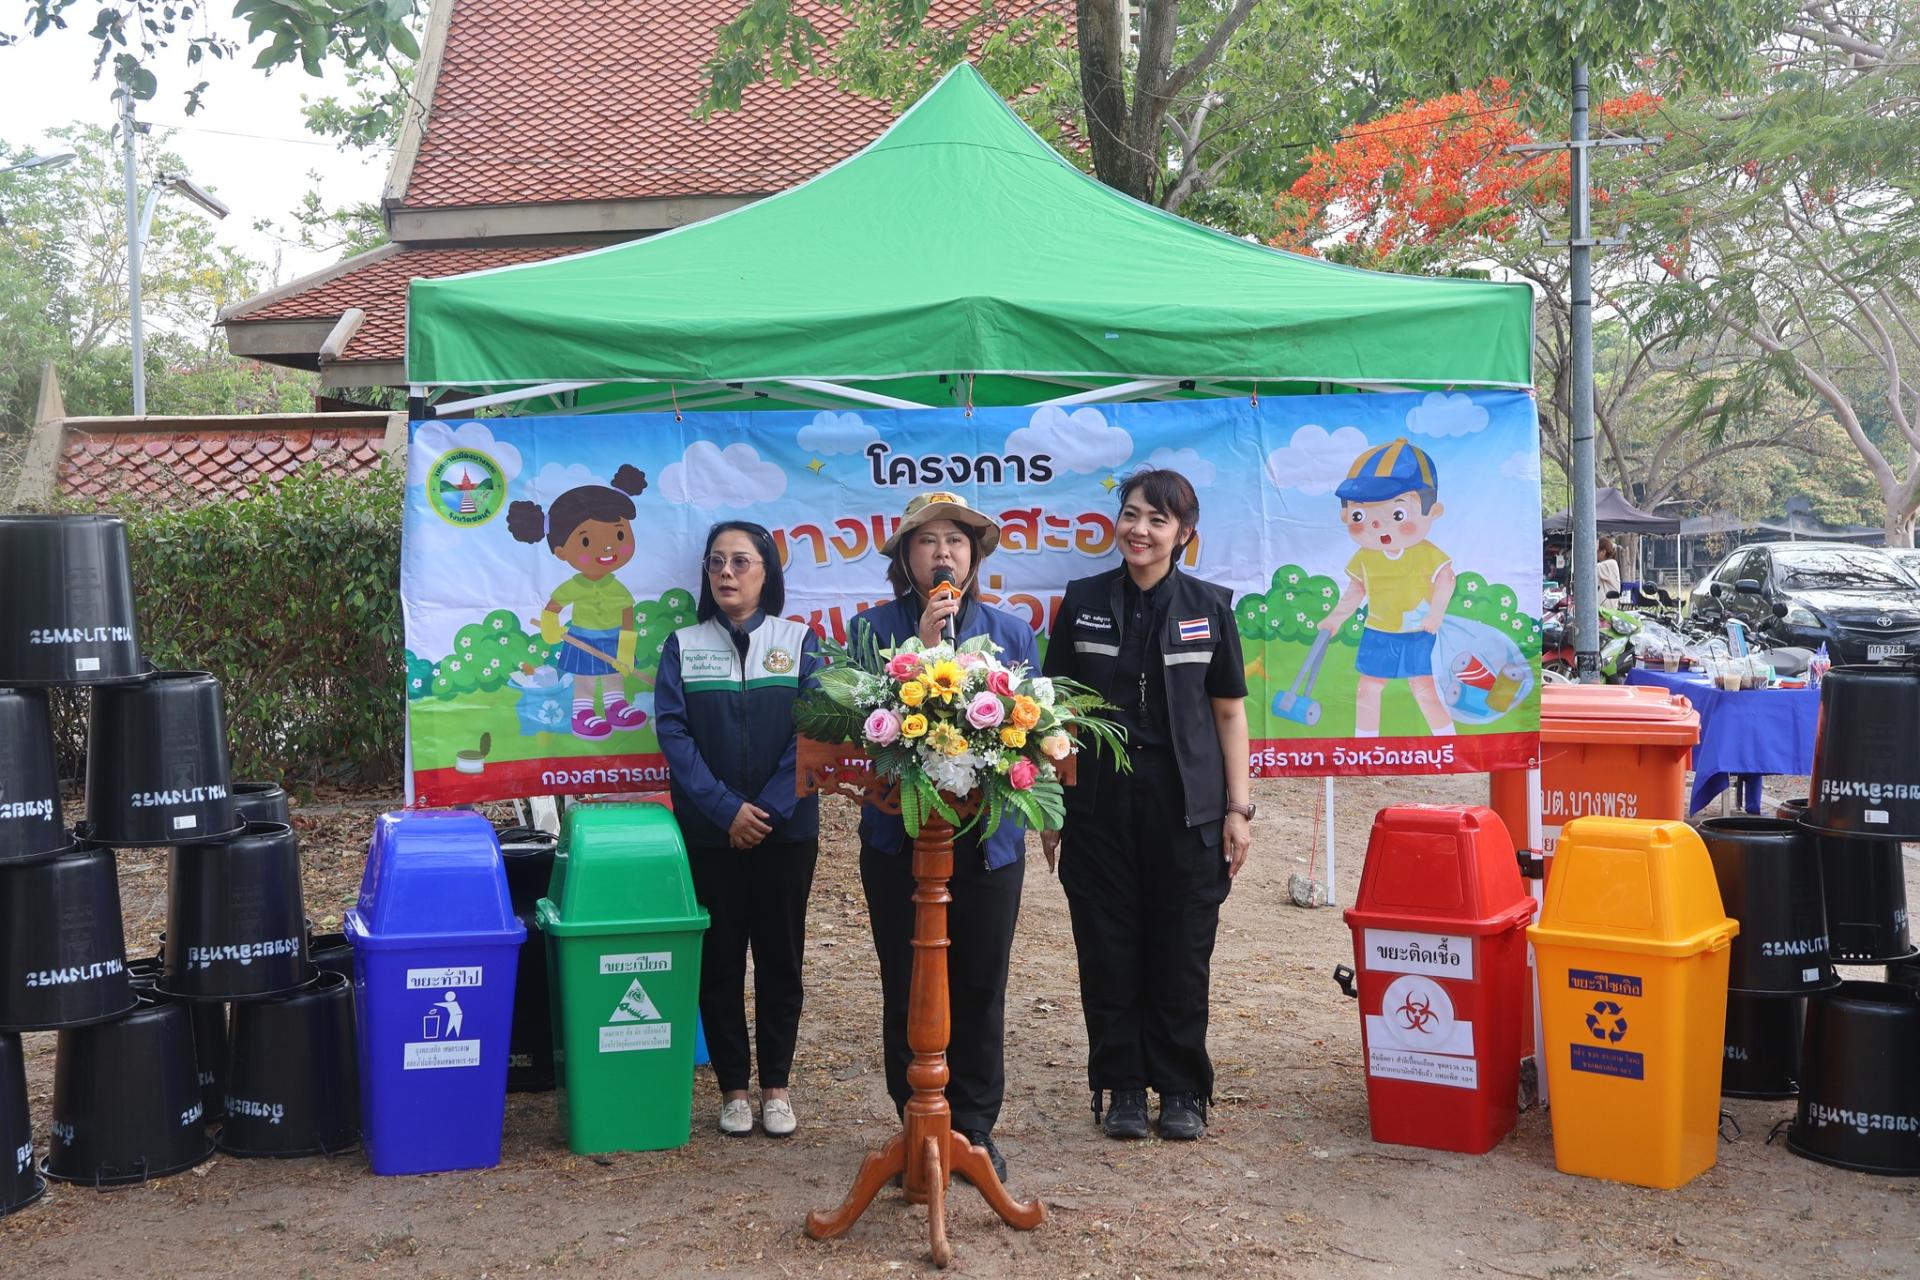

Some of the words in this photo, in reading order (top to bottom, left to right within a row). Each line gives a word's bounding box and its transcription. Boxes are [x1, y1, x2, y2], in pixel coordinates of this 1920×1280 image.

[868, 444, 1052, 484] โครงการ
[1249, 747, 1324, 767] ศรีราชา
[1332, 744, 1454, 769] จังหวัดชลบุรี
[1376, 937, 1460, 967] ขยะติดเชื้อ
[604, 956, 668, 973] ขยะเปียก
[410, 969, 479, 987] ขยะทั่วไป
[1460, 1065, 1474, 1073] ATK
